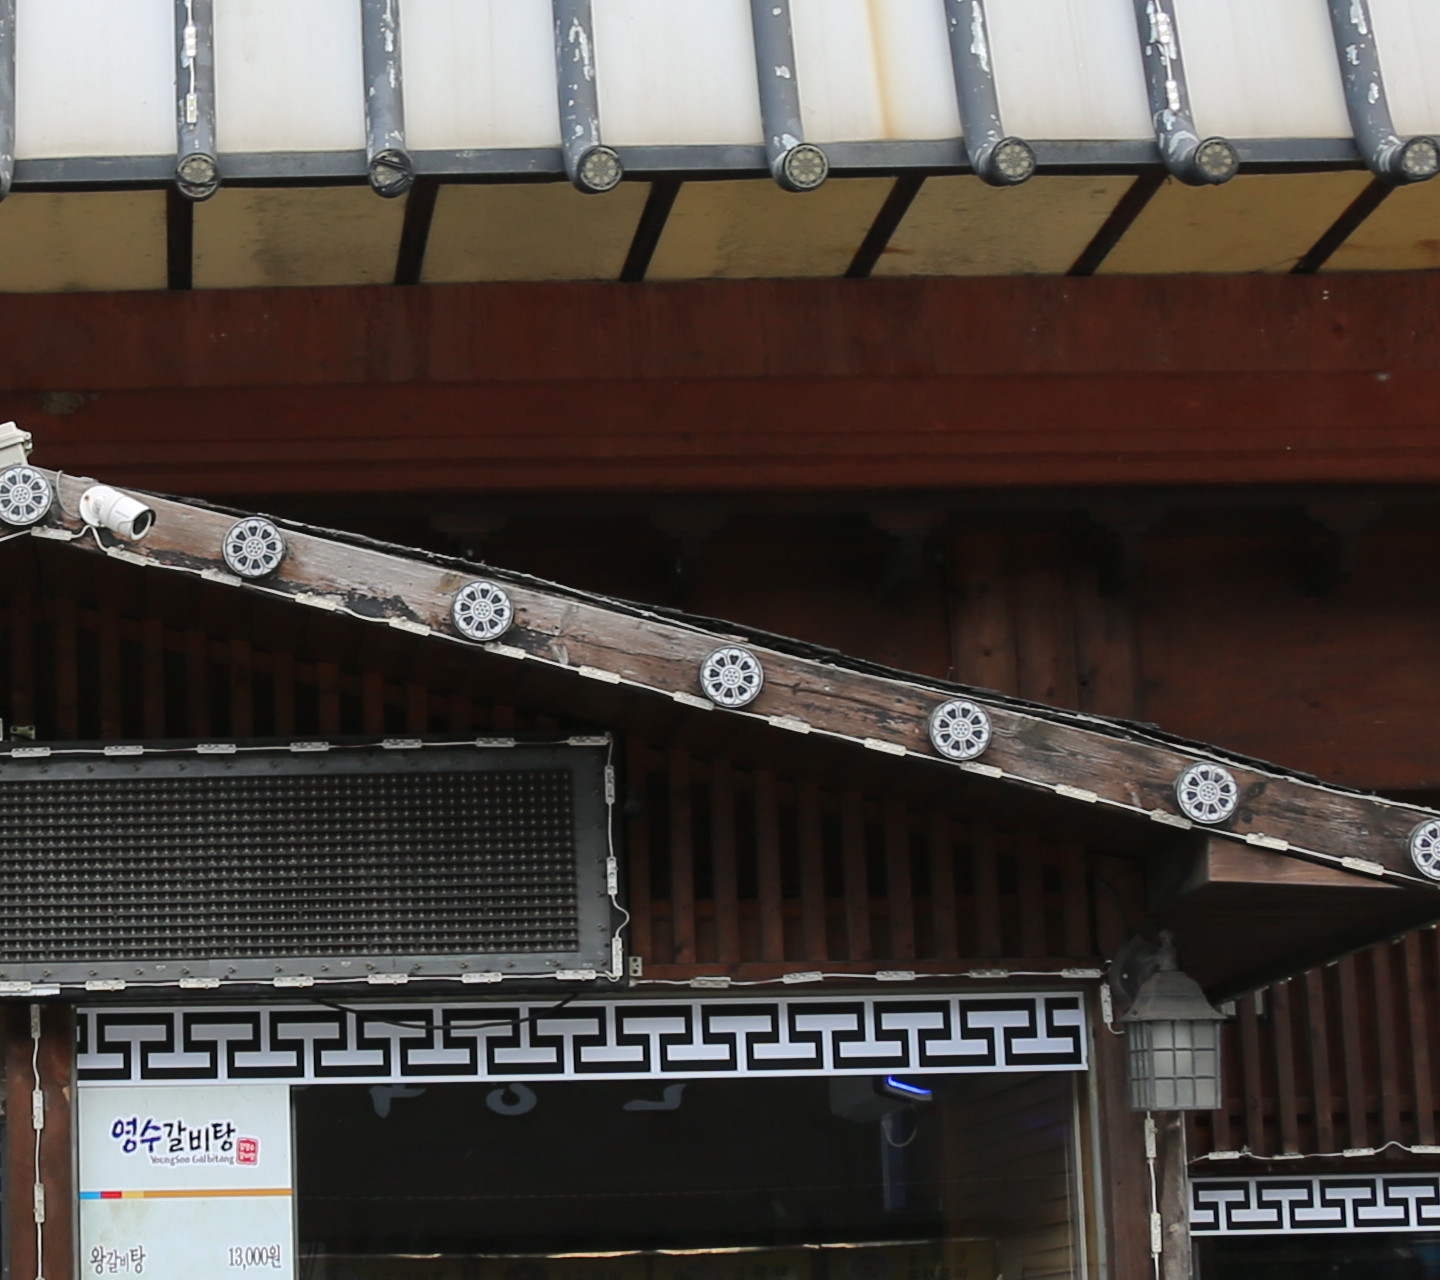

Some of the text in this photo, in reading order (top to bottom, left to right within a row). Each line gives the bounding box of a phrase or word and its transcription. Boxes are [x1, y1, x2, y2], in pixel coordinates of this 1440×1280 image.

[111, 1117, 236, 1154] 영수갈비탕
[90, 1244, 282, 1274] 왕갈비탕 13,000원
